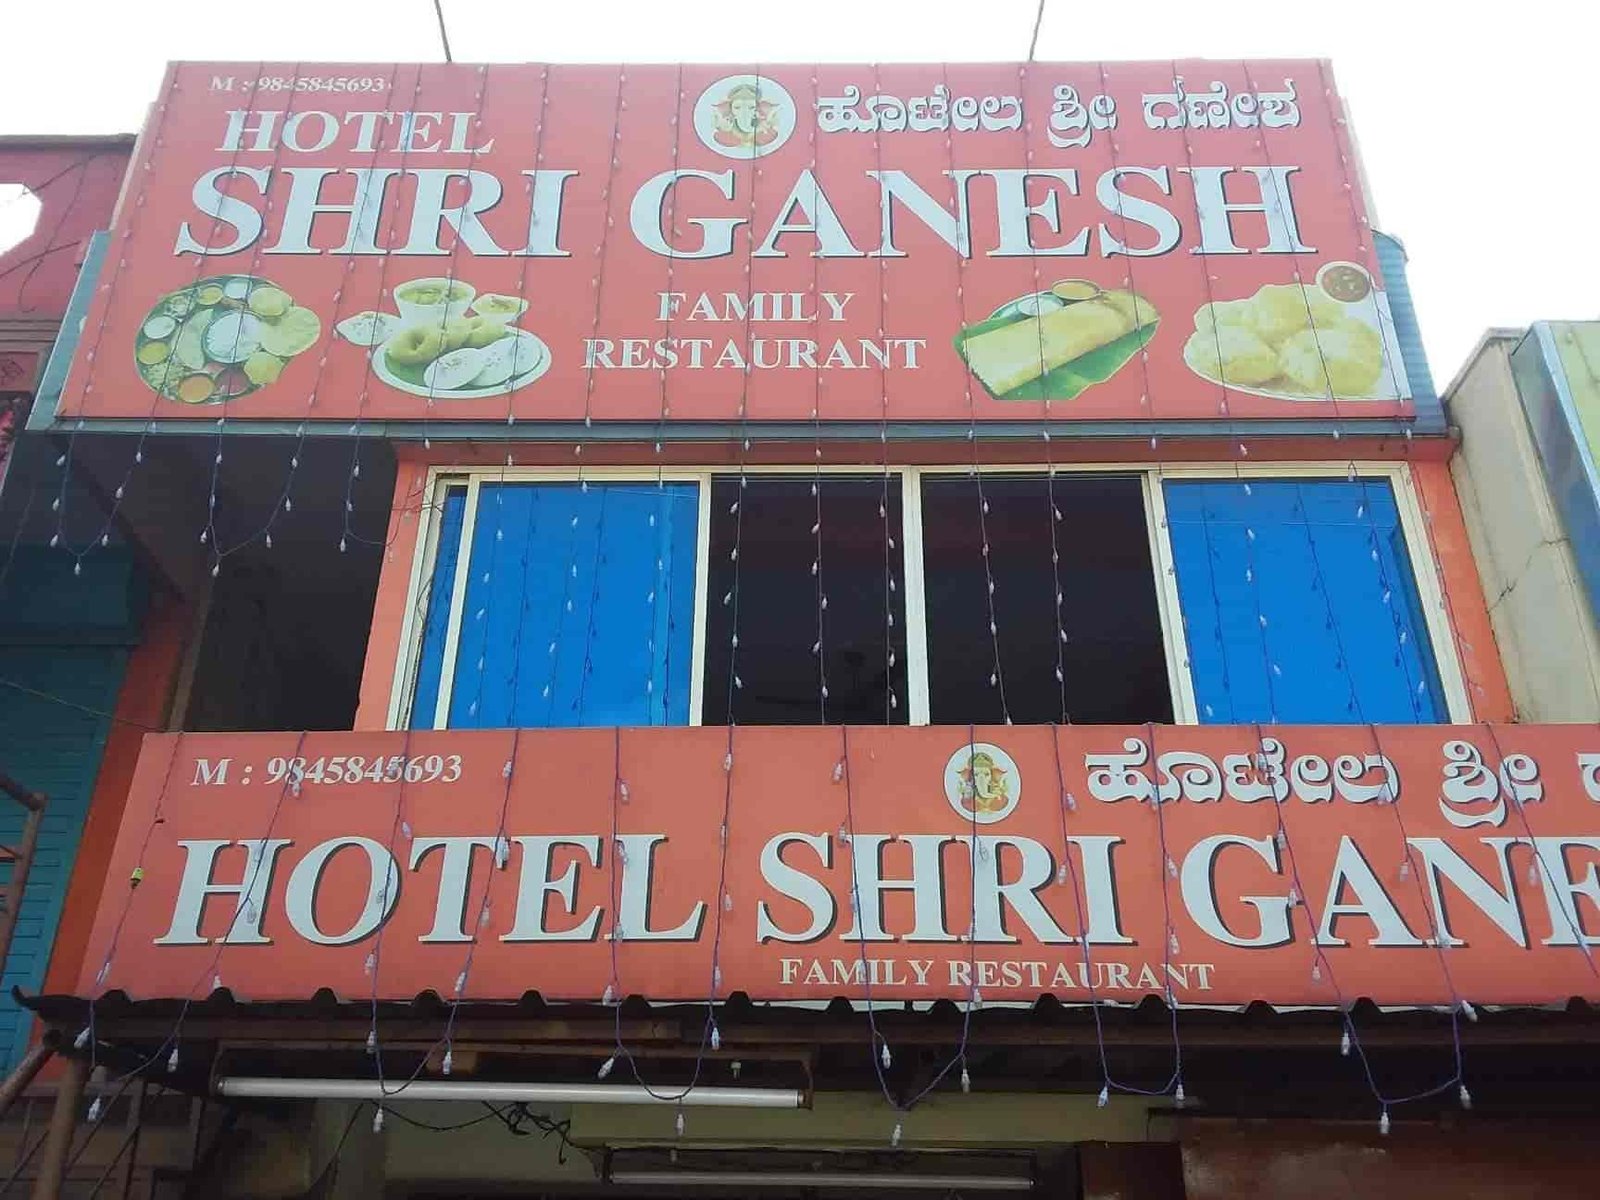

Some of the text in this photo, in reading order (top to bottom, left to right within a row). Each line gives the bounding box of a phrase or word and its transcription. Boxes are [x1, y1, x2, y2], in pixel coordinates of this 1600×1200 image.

[208, 75, 236, 91] M
[257, 76, 385, 92] 9845845693
[1046, 83, 1117, 149] ಶ್ರೀ
[1141, 75, 1300, 131] ಗಣೇಶ
[215, 109, 496, 155] HOTEL
[173, 164, 1318, 259] SHRI GANESH
[655, 291, 857, 323] FAMILY
[582, 338, 927, 370] RESTAURANT
[190, 758, 233, 786] M
[264, 754, 462, 786] 9845845693
[1438, 738, 1546, 829] ಶ್ರೀ
[153, 832, 708, 946] HOTEL
[756, 831, 1138, 948] SHRI
[779, 957, 1216, 990] FAMILY RESTAURANT
